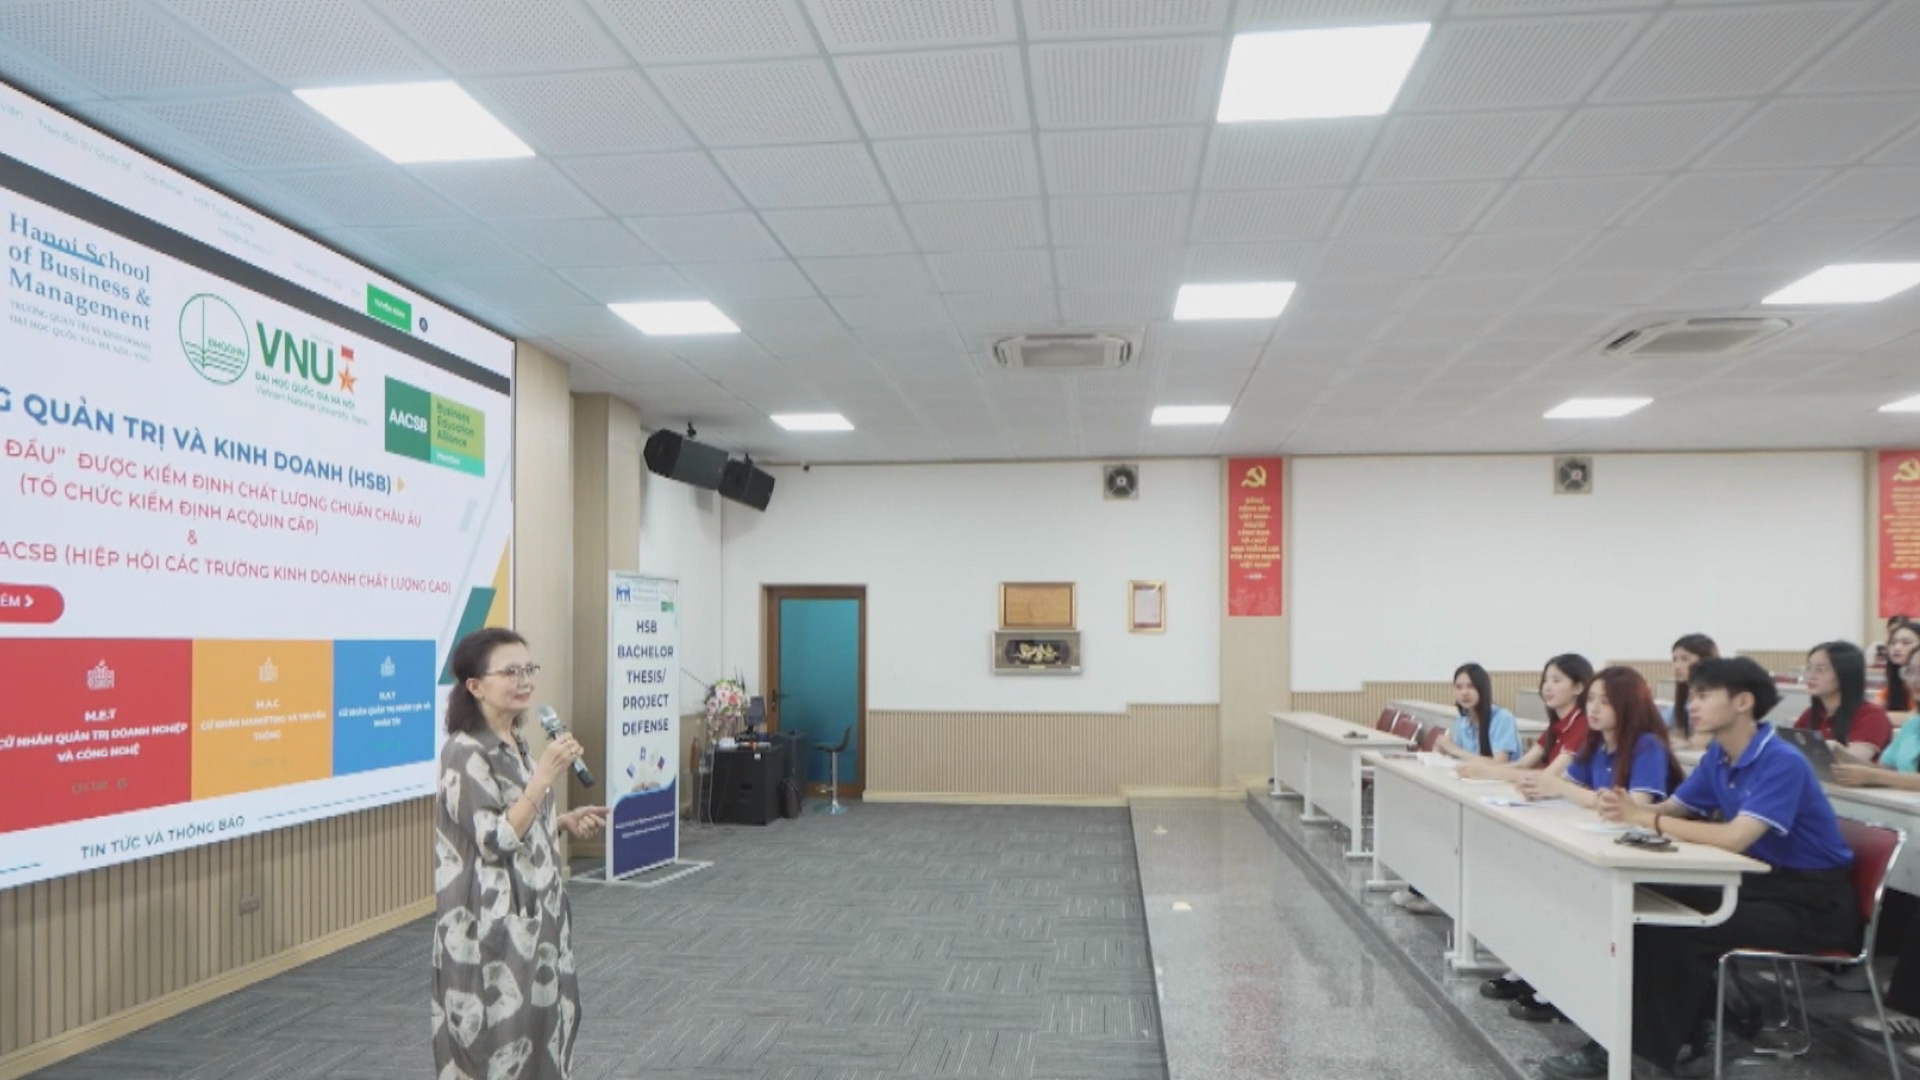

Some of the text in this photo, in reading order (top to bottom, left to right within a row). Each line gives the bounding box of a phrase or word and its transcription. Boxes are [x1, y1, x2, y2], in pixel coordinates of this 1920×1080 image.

[9, 212, 151, 284] Hanoi School
[8, 245, 152, 307] of Business &
[10, 265, 151, 331] Management
[255, 319, 334, 386] VNU
[389, 407, 428, 433] AACSB
[23, 393, 115, 435] QUẢN
[123, 414, 165, 452] TRỊ
[173, 427, 207, 455] VÀ
[214, 435, 267, 467] KINH
[274, 450, 343, 483] DOANH
[348, 465, 391, 495] (HSB)
[77, 452, 137, 479] ĐƯỢC
[192, 473, 234, 495] ĐỊNH
[281, 489, 327, 513] LƯỢNG
[64, 481, 123, 507] CHỨC
[179, 499, 222, 521] ĐỊNH
[226, 507, 284, 529] ACQUIN
[187, 529, 198, 545] &
[65, 543, 120, 570] (HIỆP
[126, 550, 160, 574] HỘI
[165, 553, 200, 575] CÁC
[274, 565, 307, 583] KINH
[311, 568, 355, 587] DOANH
[636, 620, 658, 634] HSB
[617, 645, 674, 659] BACHELOR
[626, 667, 667, 684] THESIS/
[622, 694, 669, 710] PROJECT
[16, 732, 53, 748] NHÂN
[111, 725, 150, 740] DOANH
[622, 718, 669, 736] DEFENSE
[57, 750, 75, 763] VÀ
[81, 843, 106, 860] TIN
[111, 835, 141, 853] TỨC
[145, 828, 165, 847] VÀ
[168, 821, 215, 842] THÔNG
